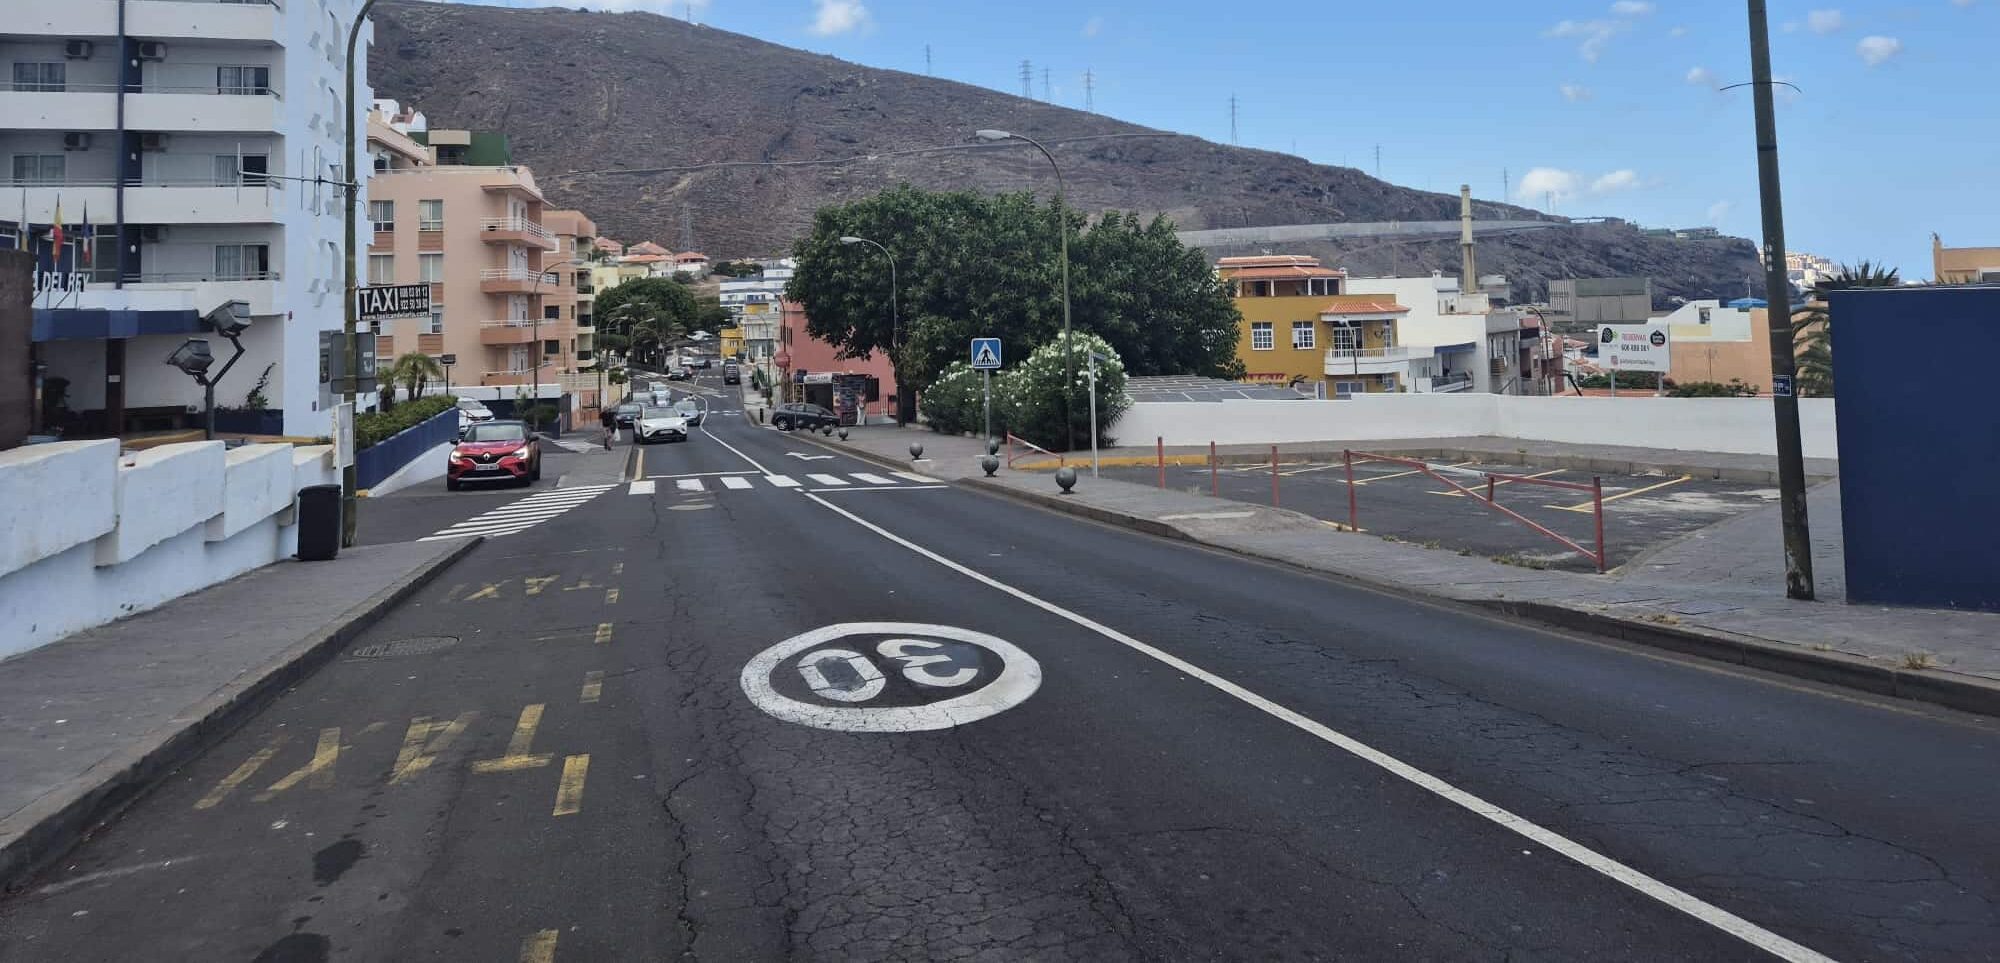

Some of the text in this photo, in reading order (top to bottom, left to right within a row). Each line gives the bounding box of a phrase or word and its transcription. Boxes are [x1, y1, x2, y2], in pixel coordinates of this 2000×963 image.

[43, 271, 65, 292] DEL
[67, 272, 90, 293] REY
[360, 288, 399, 313] TAXI
[797, 638, 979, 702] 30
